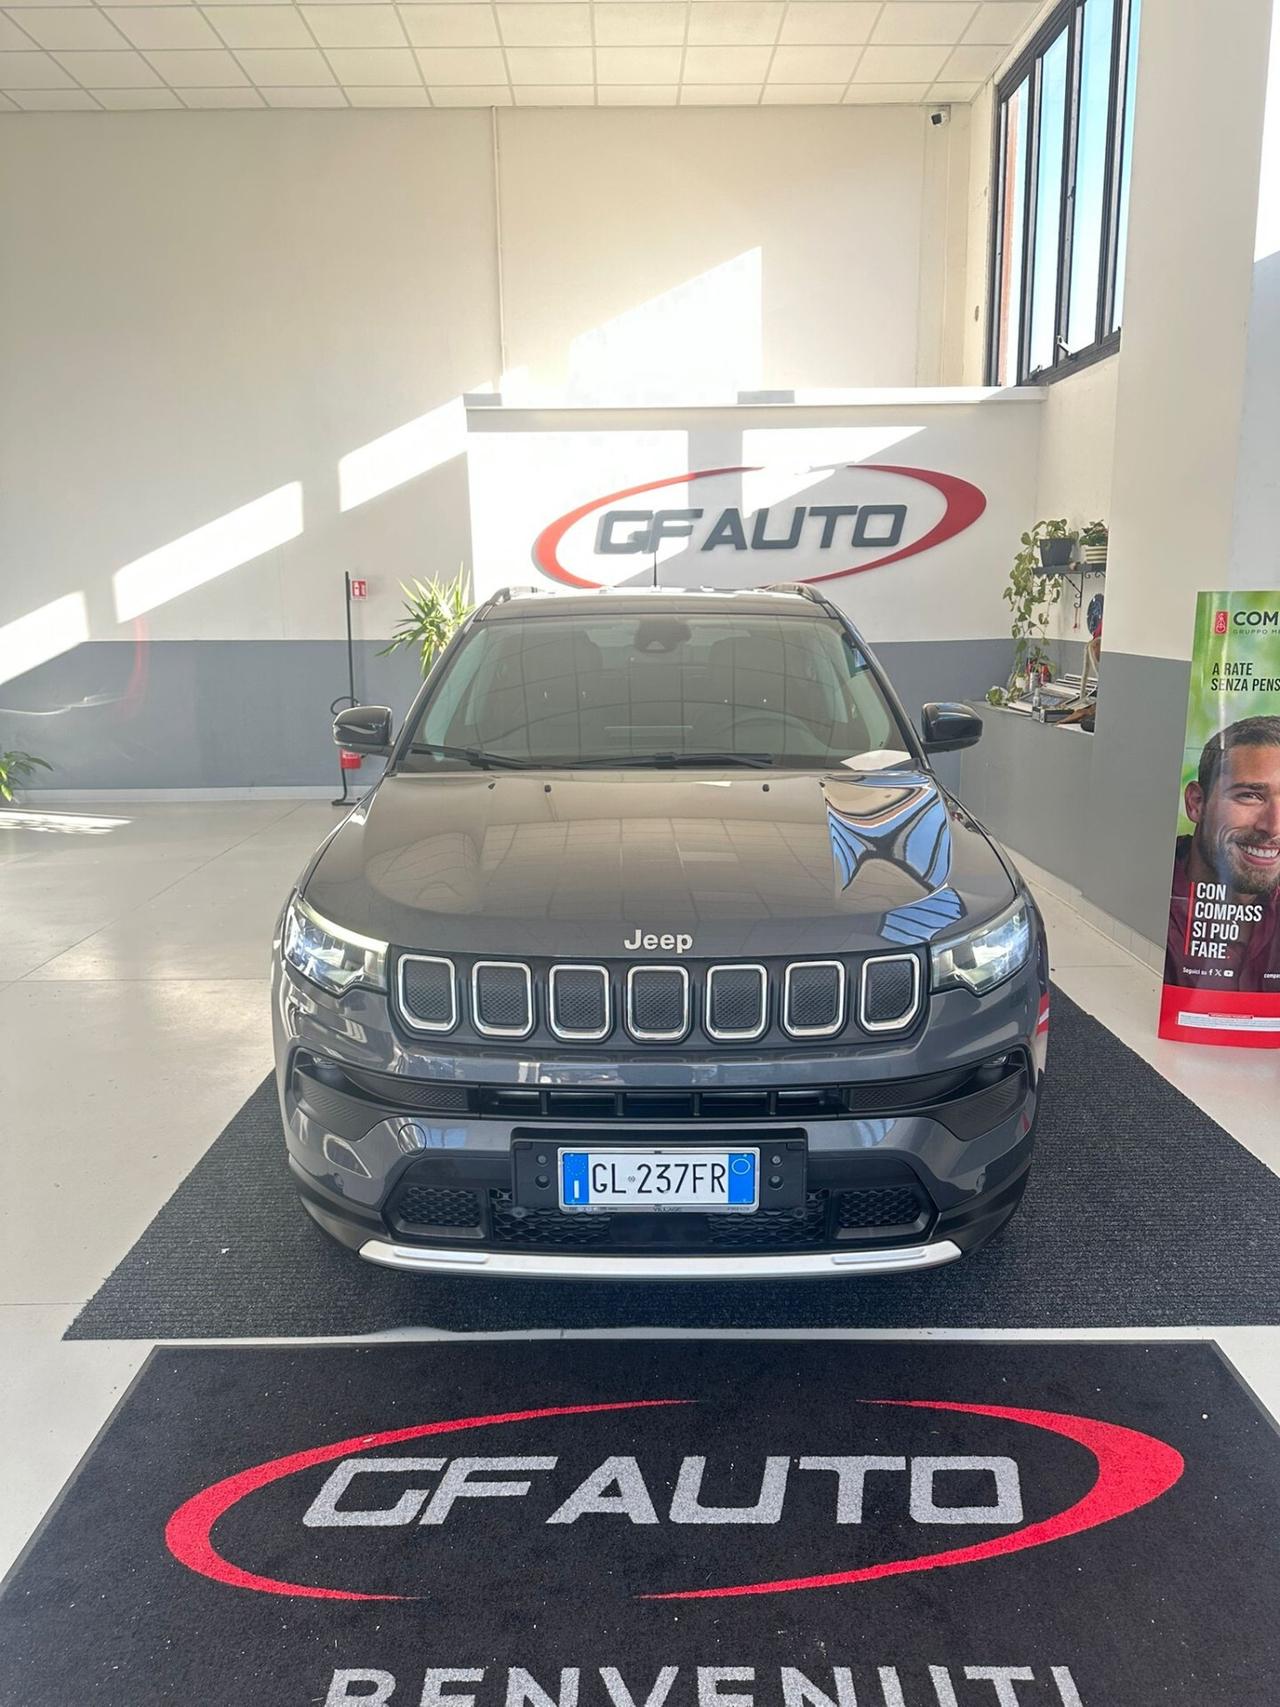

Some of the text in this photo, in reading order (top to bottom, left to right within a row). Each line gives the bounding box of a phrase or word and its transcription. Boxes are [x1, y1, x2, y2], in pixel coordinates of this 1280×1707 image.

[1233, 611, 1279, 626] COM
[1212, 663, 1253, 676] A RATE
[1211, 678, 1280, 691] SENZA PENS
[1196, 882, 1226, 900] CON
[1194, 901, 1263, 922] COMPASS
[1192, 921, 1239, 940] SI PUÒ
[624, 929, 692, 953] Jeep
